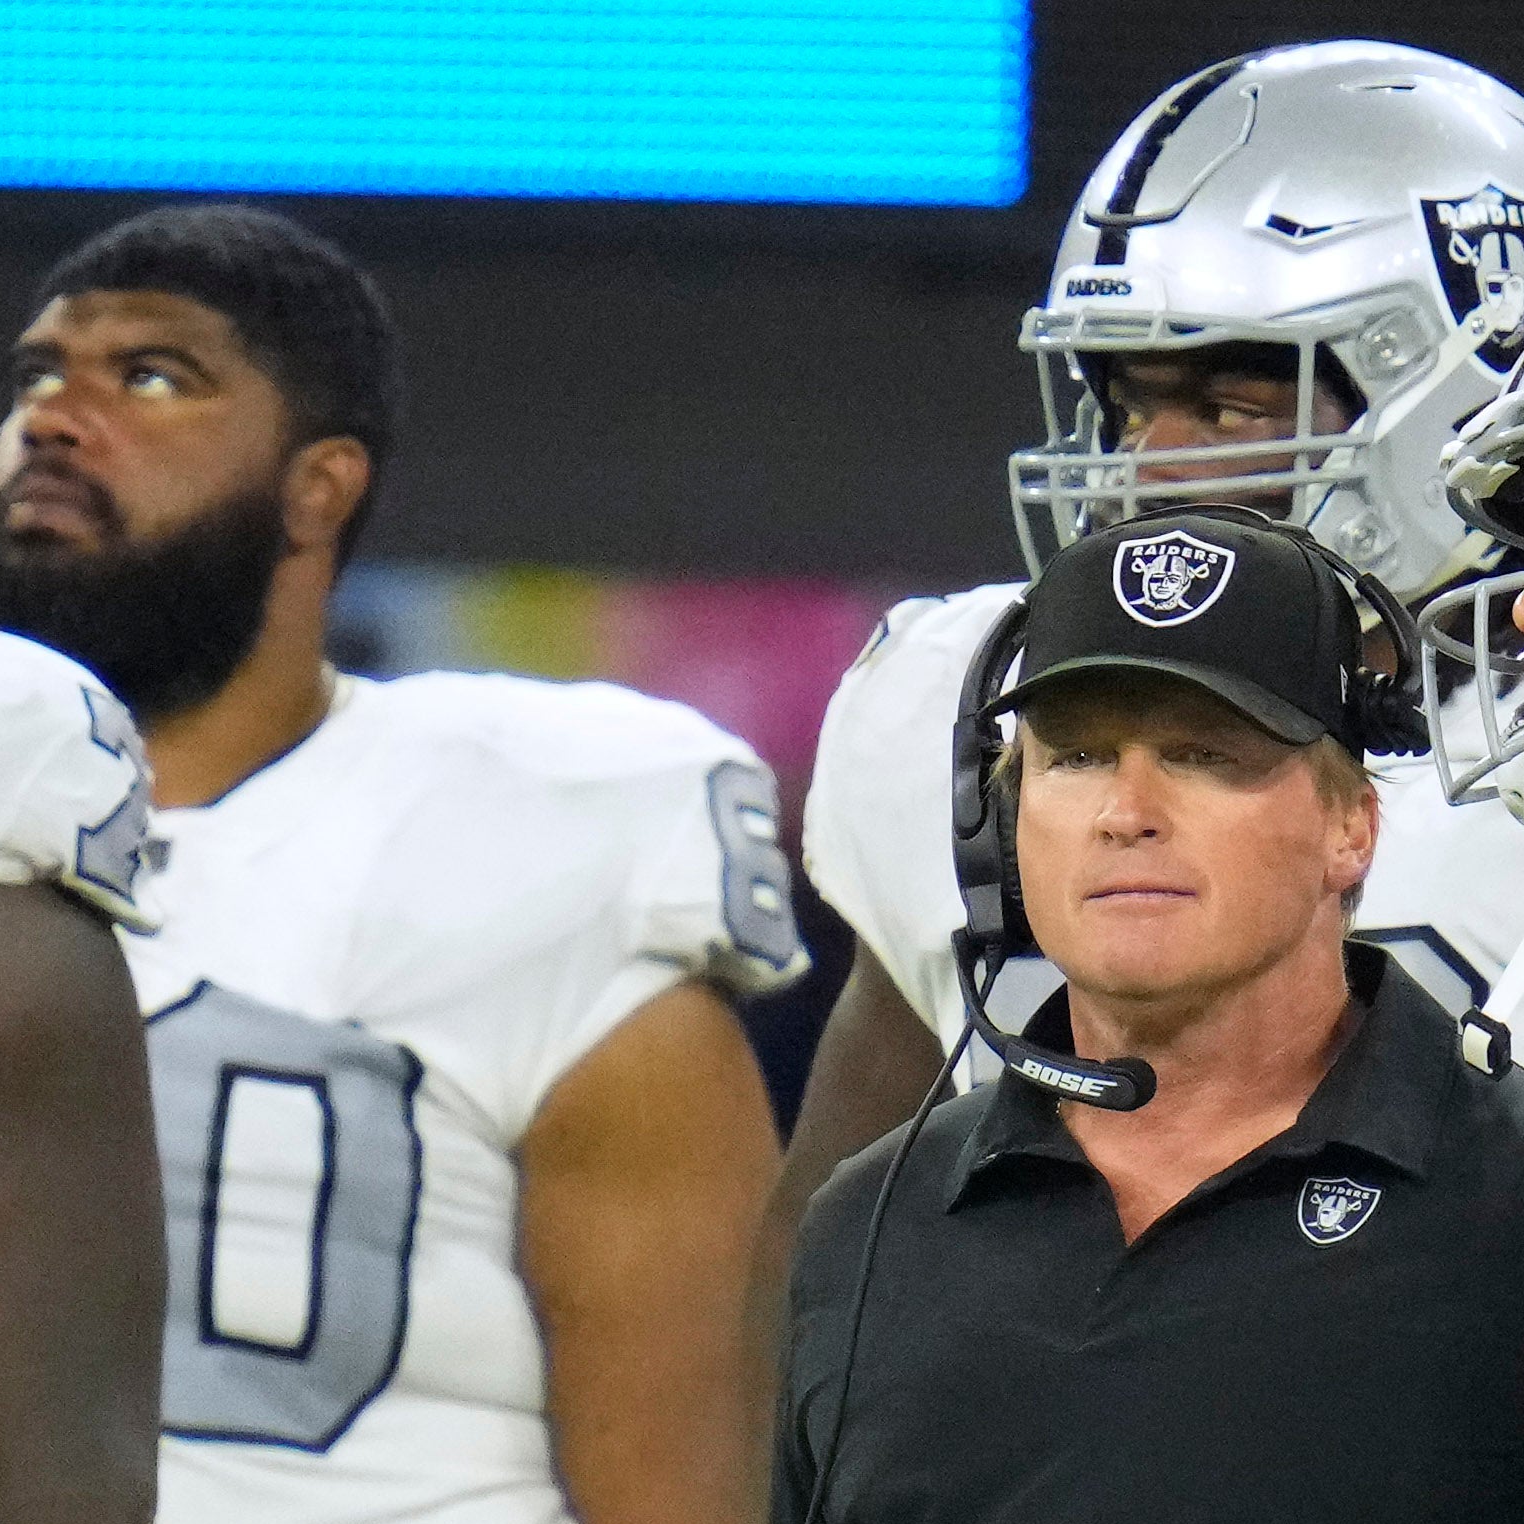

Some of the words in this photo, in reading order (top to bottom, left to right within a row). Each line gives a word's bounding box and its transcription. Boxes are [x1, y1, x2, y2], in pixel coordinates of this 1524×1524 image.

[1132, 544, 1219, 564] RAIDERS
[1010, 1058, 1118, 1097] BOSE
[1313, 1182, 1371, 1200] RAIDERS
